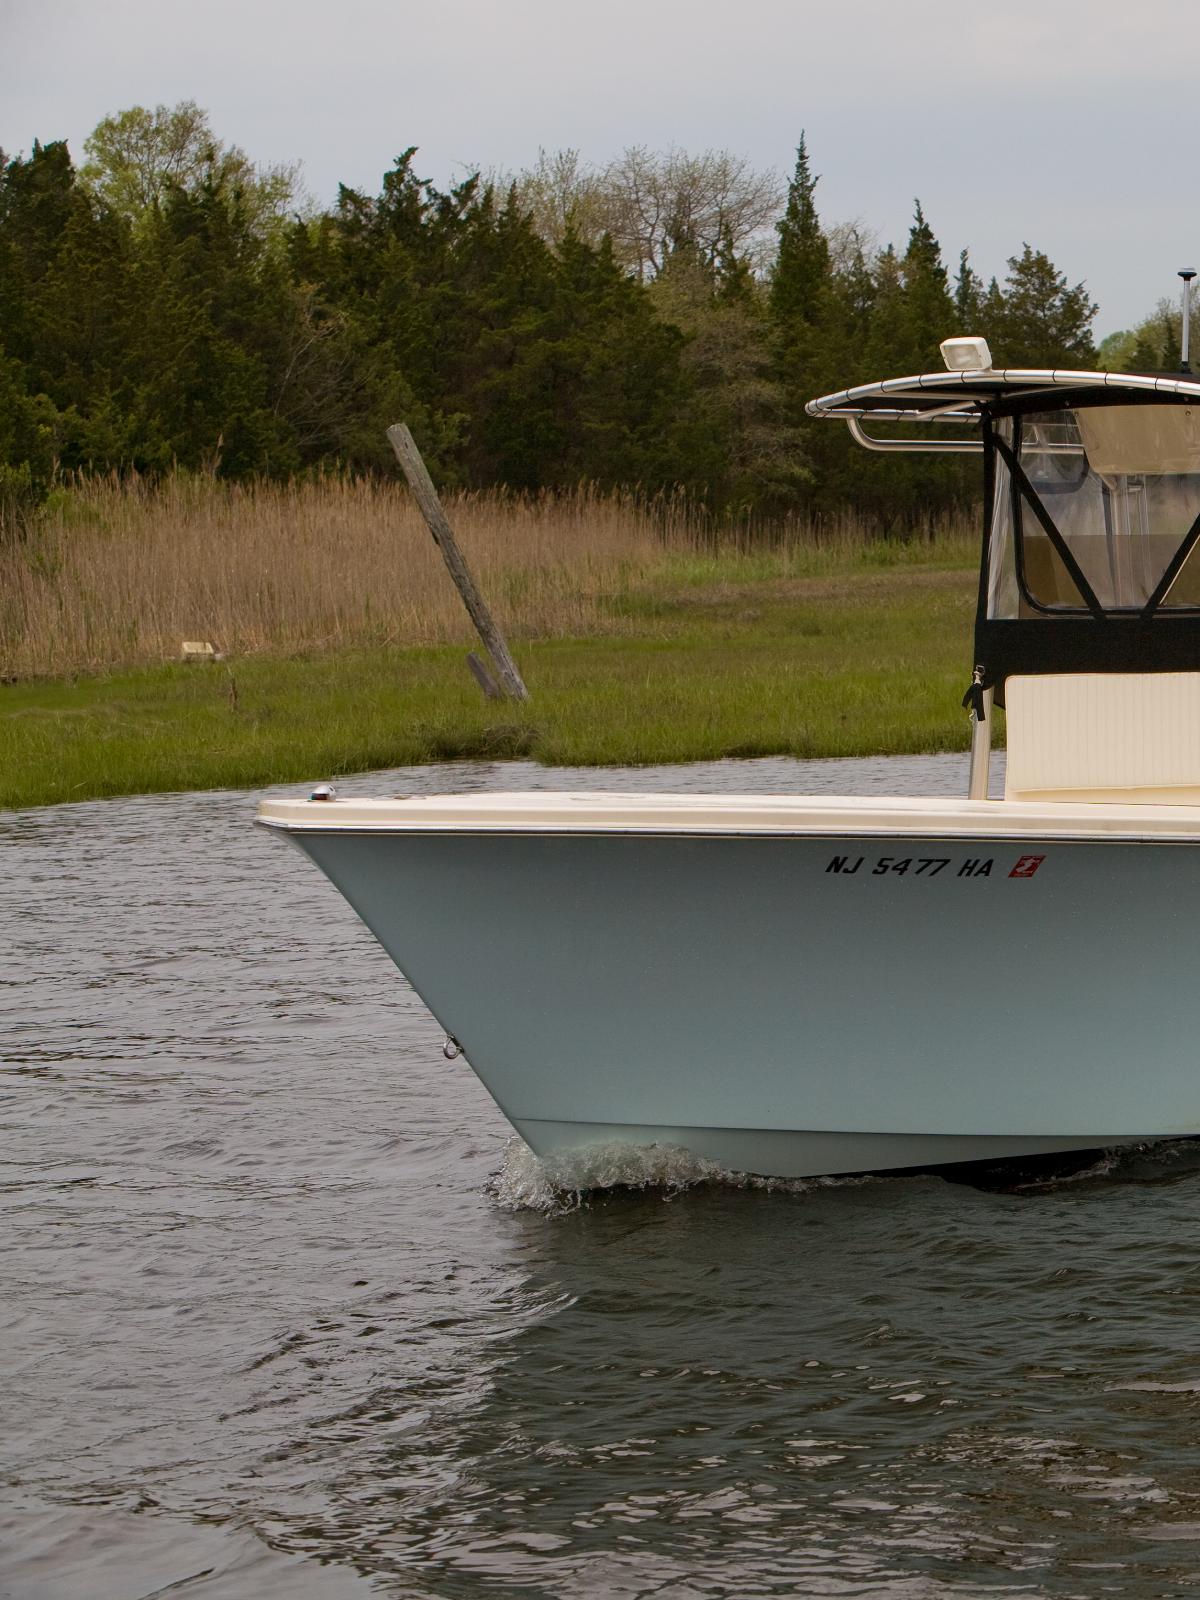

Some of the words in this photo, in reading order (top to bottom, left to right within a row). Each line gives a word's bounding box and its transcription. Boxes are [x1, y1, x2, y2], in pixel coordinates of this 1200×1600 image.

[825, 856, 865, 874] NJ
[872, 857, 951, 877] 5477
[957, 859, 994, 877] HA
